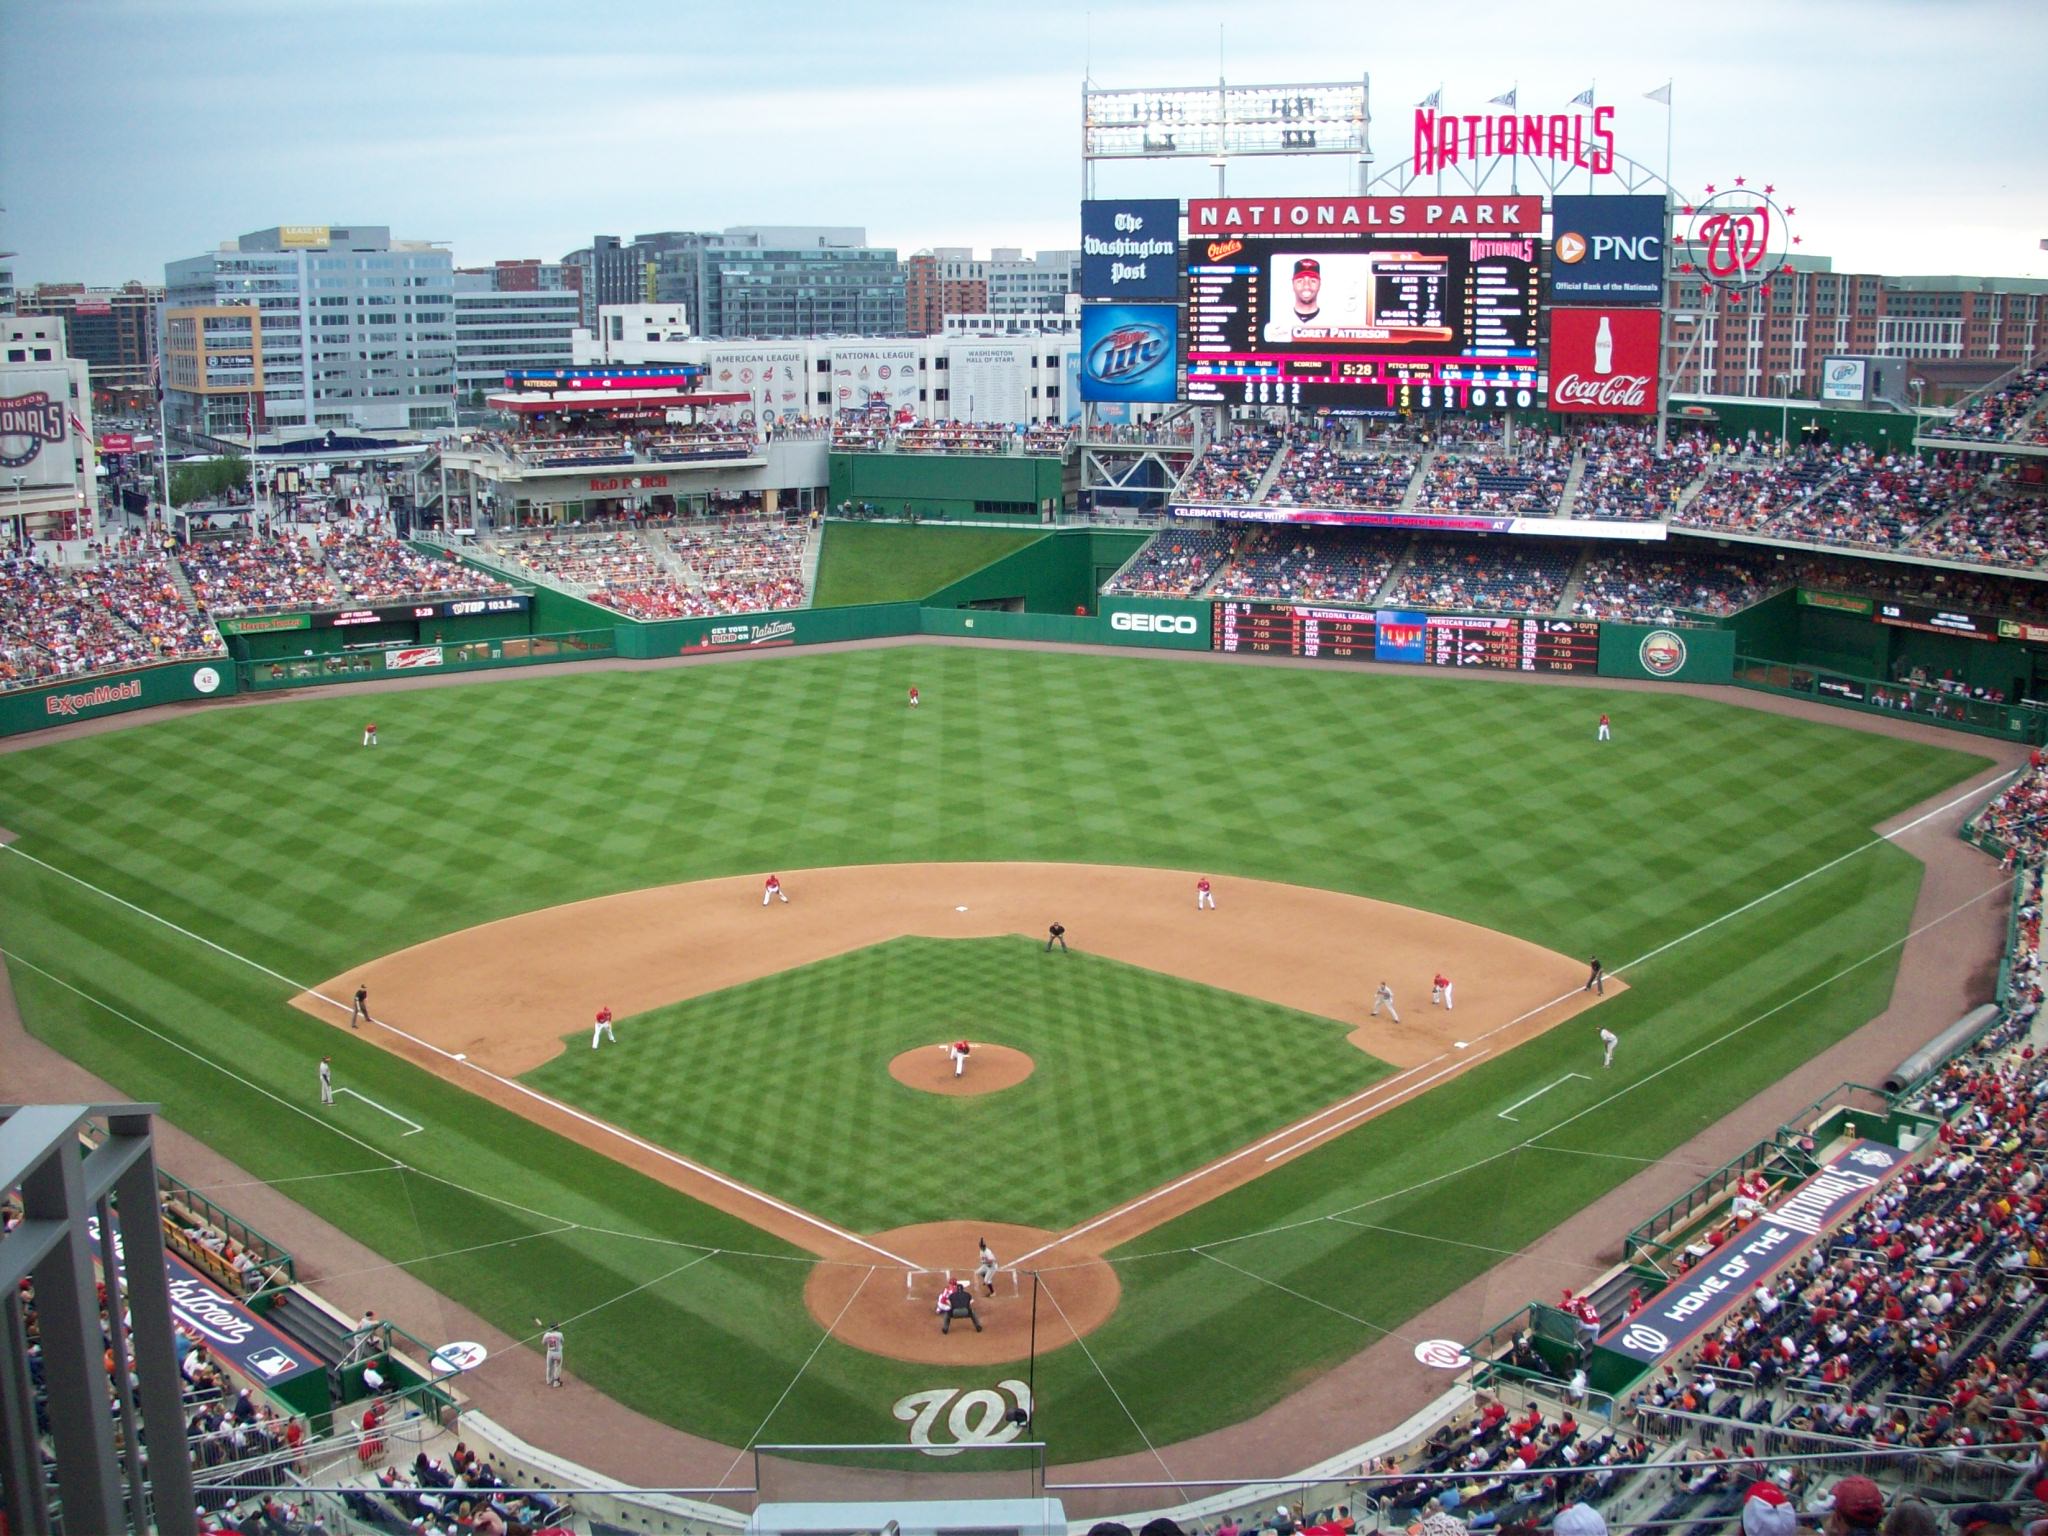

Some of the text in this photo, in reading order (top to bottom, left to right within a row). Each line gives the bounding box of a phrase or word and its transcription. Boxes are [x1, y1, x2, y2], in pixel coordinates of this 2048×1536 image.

[1414, 106, 1614, 175] NATIONALS
[1200, 205, 1522, 225] NATIONALS PARK
[1114, 213, 1143, 232] The
[1084, 235, 1174, 258] Washington
[1469, 240, 1533, 262] NATIONALS
[1594, 235, 1659, 261] PNC
[1111, 262, 1147, 284] Post
[1555, 282, 1658, 291] Official Bank of the Nationals
[1293, 327, 1390, 339] COREY PATTERSON
[715, 353, 800, 363] AMERICAN LEAGUE
[835, 351, 915, 360] NATIONAL LEAGUE
[1100, 338, 1161, 379] Lite
[1343, 364, 1372, 375] 5:28
[1401, 386, 1410, 396] 4
[1555, 374, 1651, 406] Coca-Cola
[0, 395, 44, 408] INGTON
[1400, 396, 1409, 407] 3
[1472, 389, 1531, 407] 0 1 0
[590, 478, 618, 491] RED
[1174, 508, 1286, 520] CELEBRATE THE GAME WITH
[1493, 521, 1504, 529] AT
[1312, 611, 1348, 619] NATIONAL
[1111, 612, 1197, 634] GEICO
[1426, 618, 1463, 626] AMERICAN
[728, 625, 748, 633] YOUR
[1554, 637, 1571, 645] 7:05
[1553, 649, 1571, 657] 7:10
[1550, 662, 1572, 670] 10:10
[202, 675, 212, 684] 42
[46, 680, 142, 714] ExxonMobil
[1664, 1164, 1881, 1322] HOME OF THE NATIONALS
